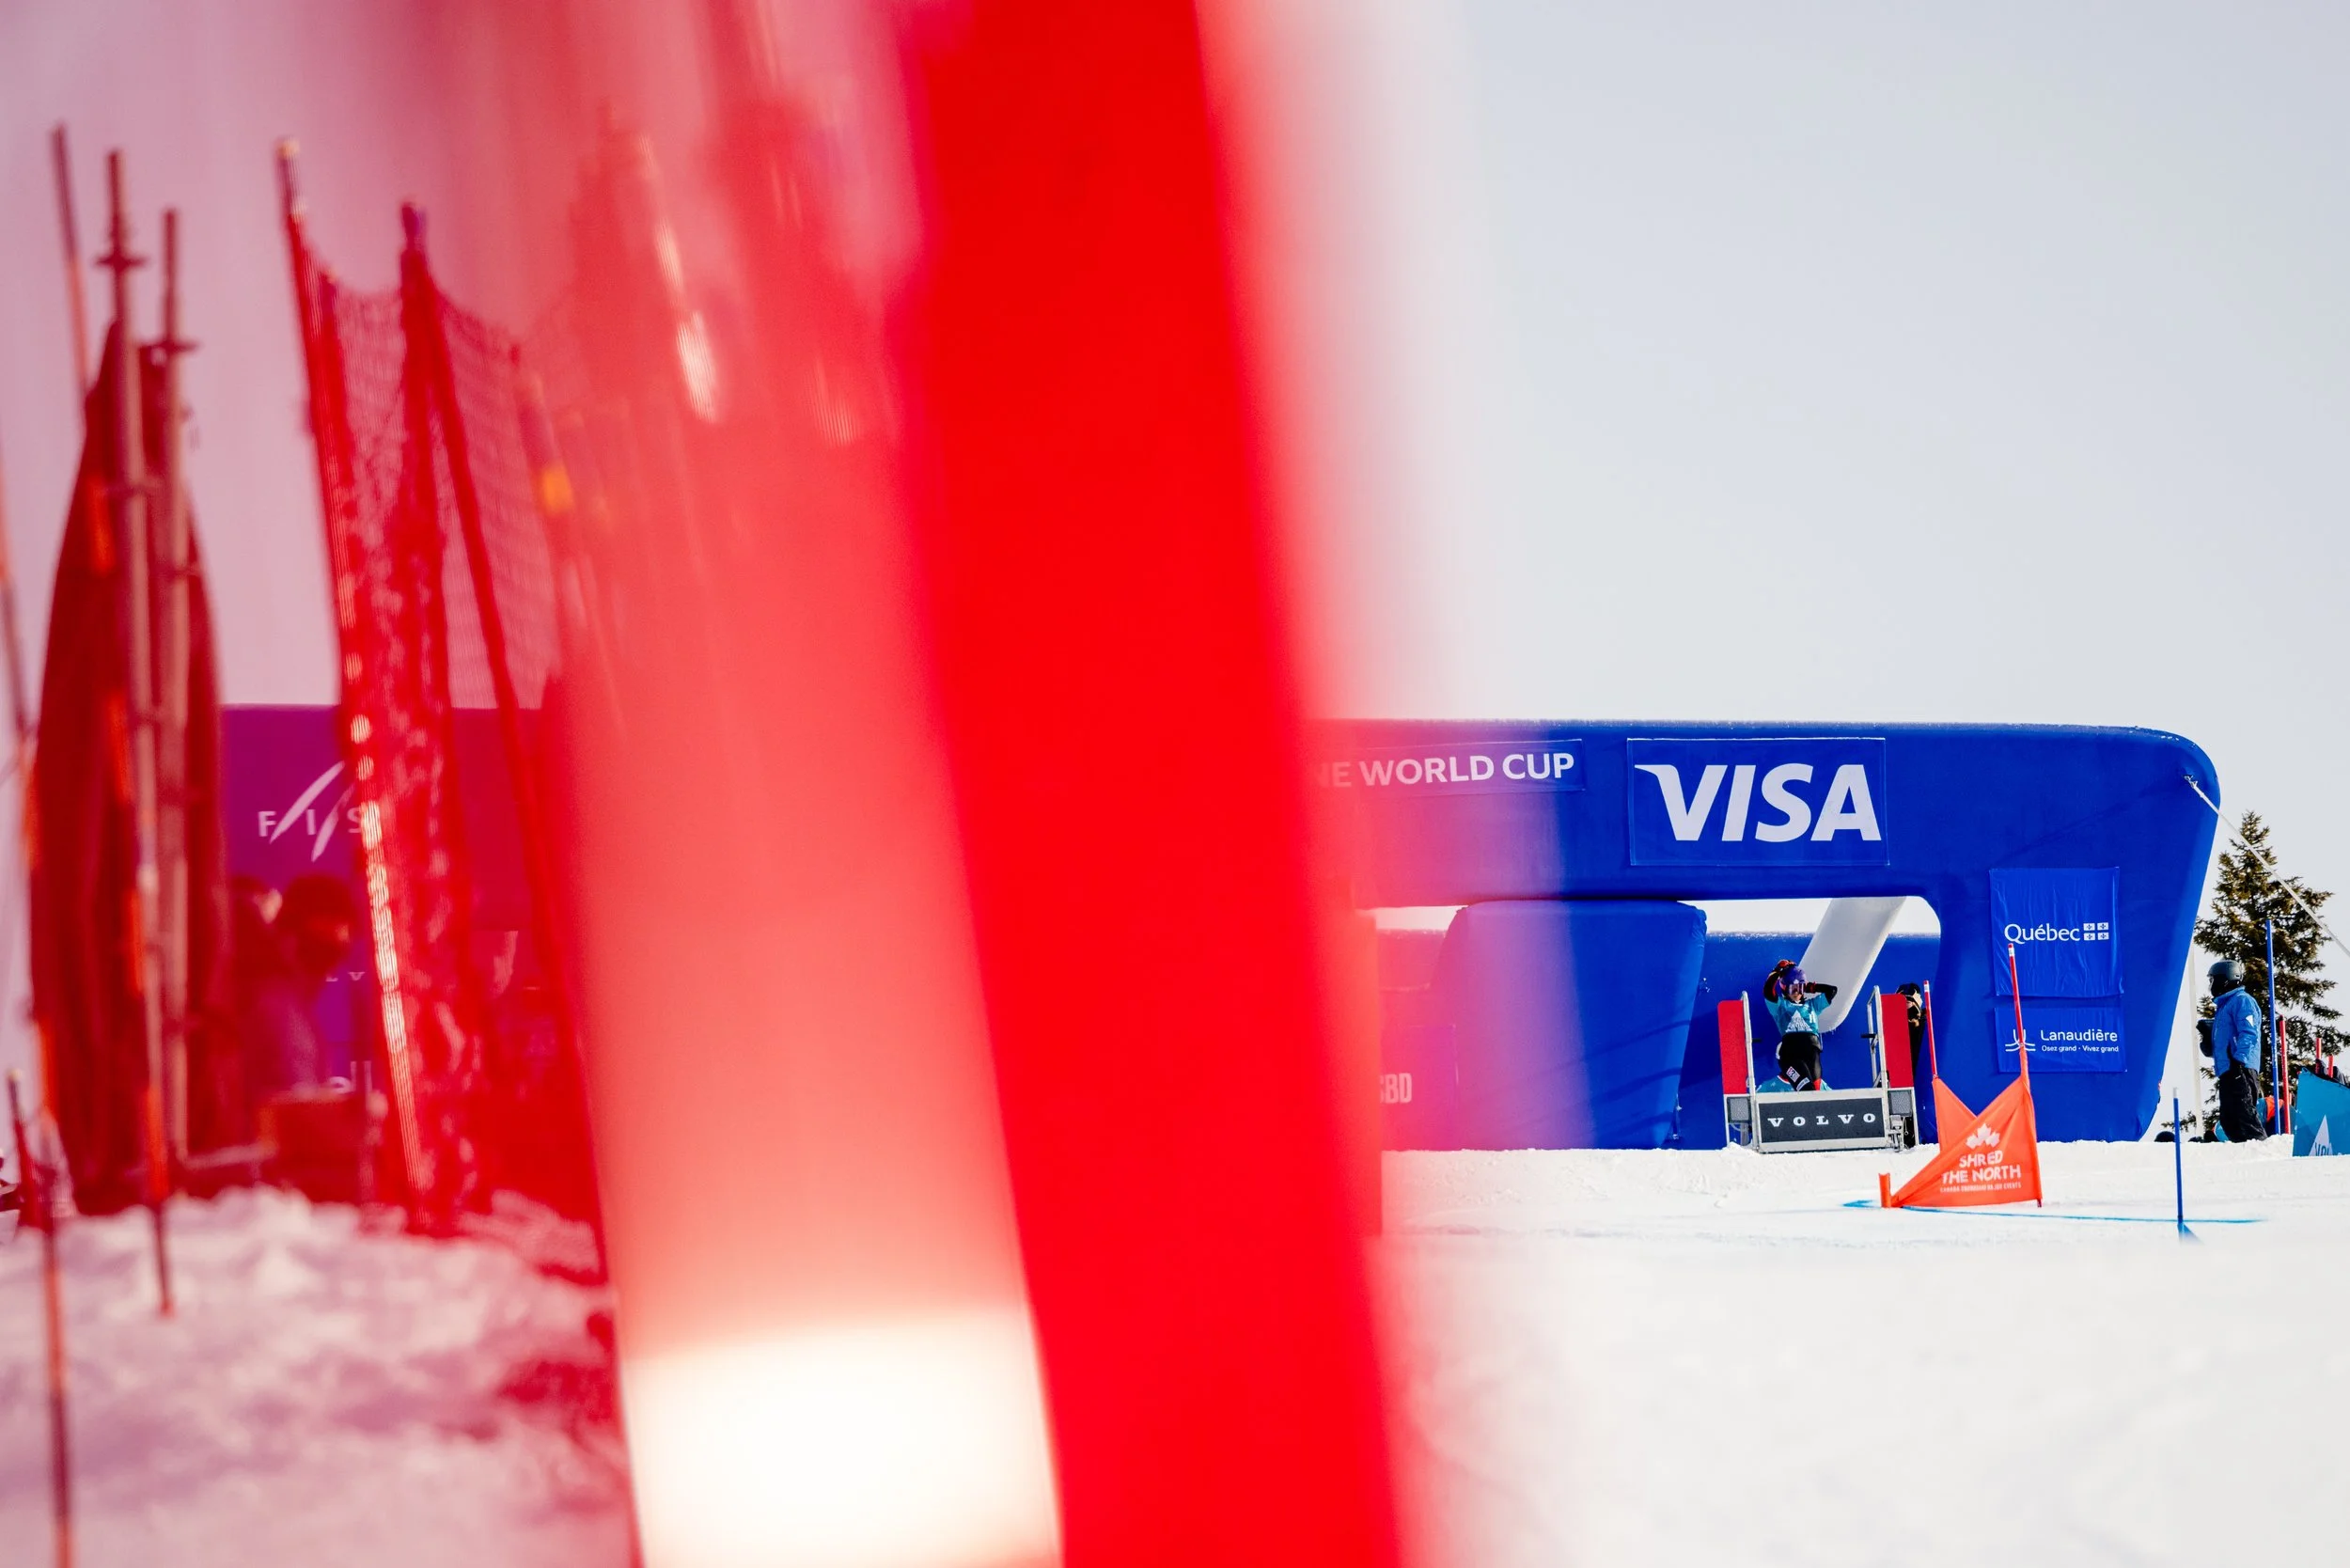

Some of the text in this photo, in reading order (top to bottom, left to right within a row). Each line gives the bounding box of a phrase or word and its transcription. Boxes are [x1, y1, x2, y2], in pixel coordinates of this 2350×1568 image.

[1359, 755, 1495, 787] WORLD
[1502, 753, 1574, 780] CUP
[1634, 762, 1881, 843] VISA
[2004, 922, 2080, 945] Québec
[2040, 1028, 2118, 1042] Lanaudière
[2059, 1044, 2077, 1053] grand
[2101, 1045, 2119, 1054] grand
[1767, 1112, 1876, 1128] VOLVO
[1959, 1150, 2003, 1168] SHRED
[1942, 1164, 2022, 1184] THE NORTH
